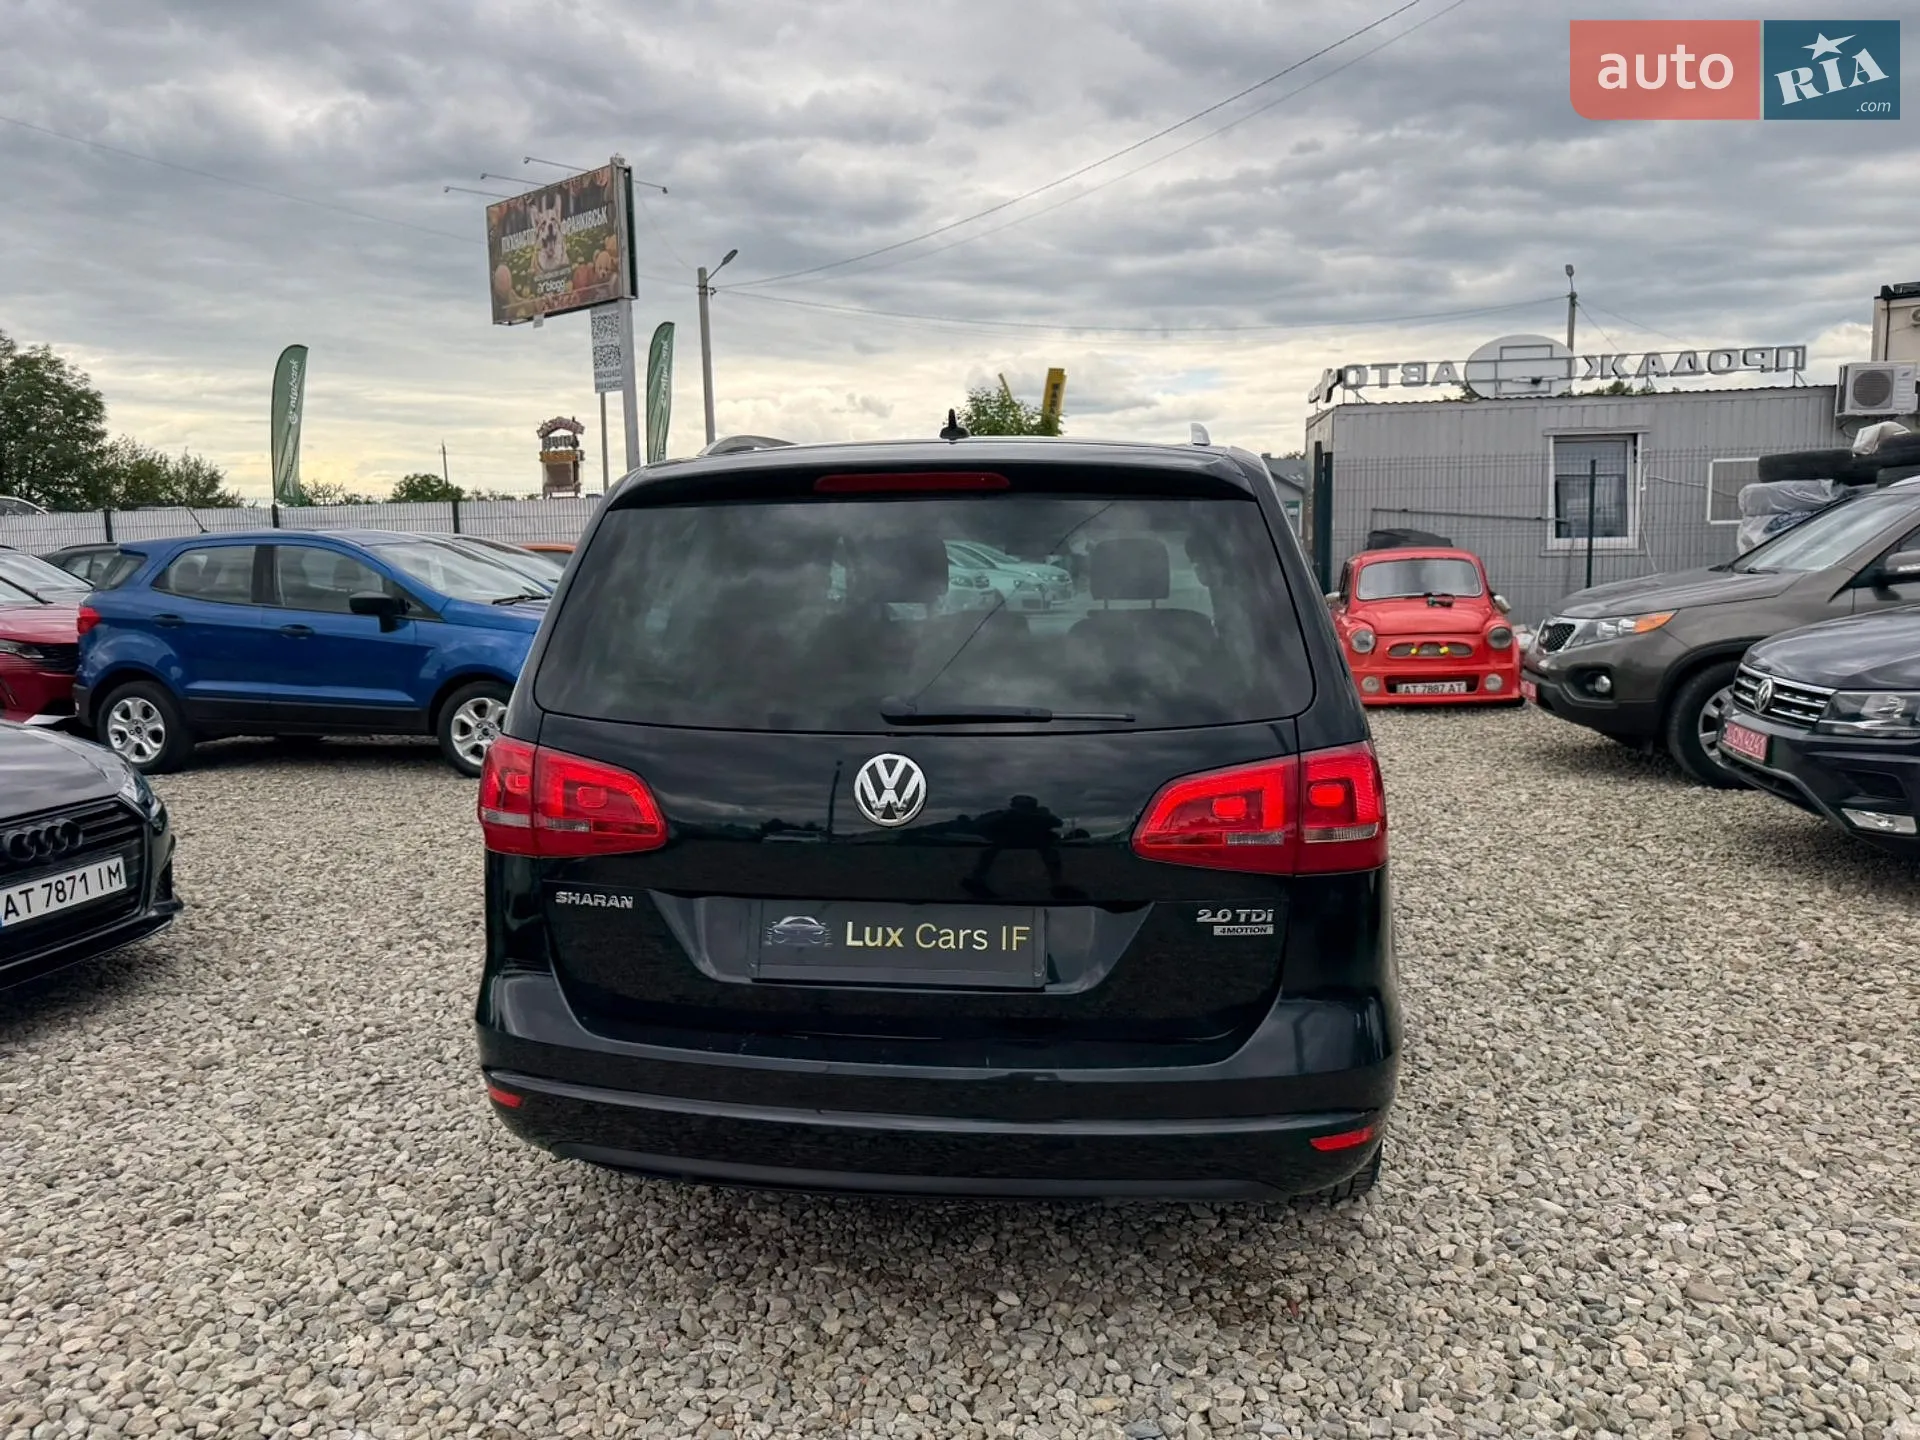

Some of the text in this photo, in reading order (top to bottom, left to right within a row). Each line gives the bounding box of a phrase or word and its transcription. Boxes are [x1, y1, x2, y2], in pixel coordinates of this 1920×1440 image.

[4, 862, 123, 920] AT 7871 IM
[555, 891, 634, 909] SHARAN
[846, 921, 1031, 950] Lux Cars IF
[1220, 926, 1268, 935] 4MOTION
